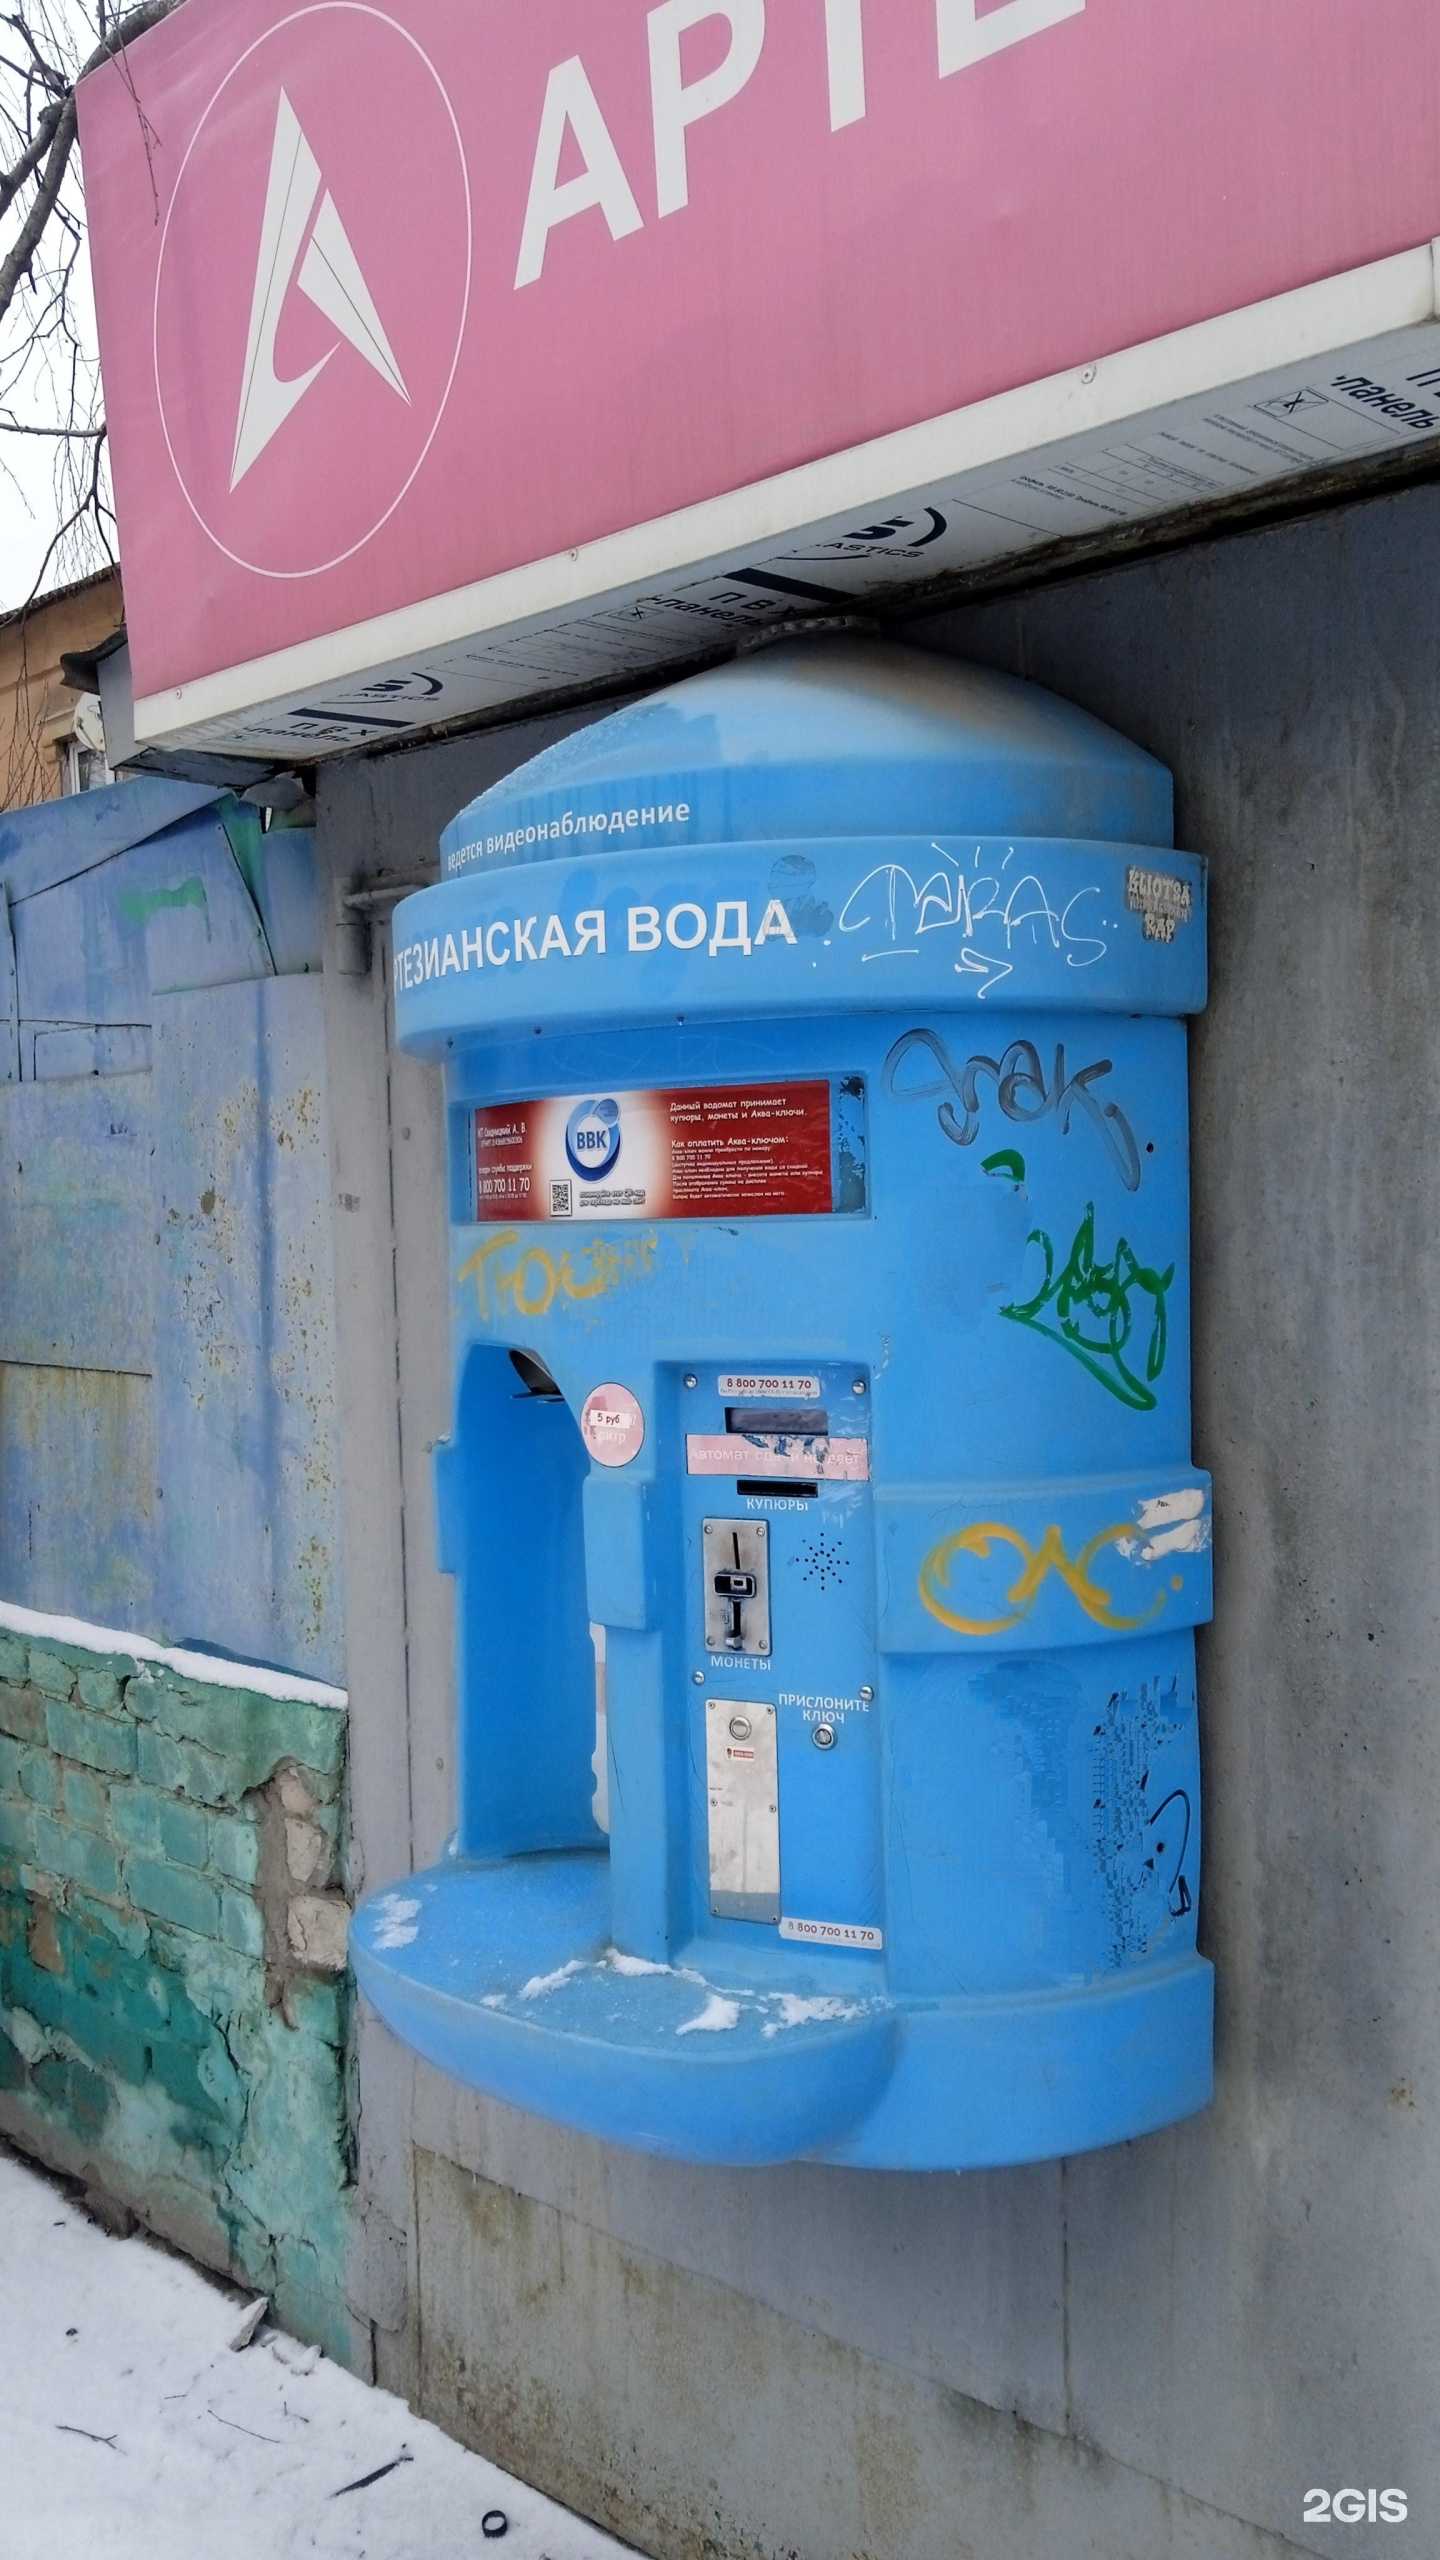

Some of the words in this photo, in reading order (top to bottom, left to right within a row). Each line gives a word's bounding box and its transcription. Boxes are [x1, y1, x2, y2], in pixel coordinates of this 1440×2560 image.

[447, 840, 483, 873] ведется
[486, 800, 691, 856] видеонаблюдение
[627, 898, 799, 958] ВОДА
[703, 1101, 737, 1110] водомат
[740, 1098, 787, 1110] принимает
[707, 1112, 739, 1121] монеты
[741, 1111, 748, 1119] и
[671, 1139, 686, 1148] Как
[687, 1139, 725, 1148] оплатить
[508, 1177, 517, 1192] 11
[519, 1176, 531, 1192] 70
[727, 1377, 733, 1388] 8
[736, 1378, 756, 1389] 800
[759, 1379, 779, 1389] 700
[782, 1380, 794, 1389] 11
[798, 1380, 812, 1390] 70
[597, 1412, 603, 1422] 5
[606, 1414, 621, 1426] руб
[746, 1498, 809, 1511] КУПЮРЫ
[710, 1656, 771, 1671] МОНЕТЫ
[778, 1693, 870, 1713] ПРИСЛОНИТЕ
[802, 1710, 846, 1724] КЛЮЧ
[797, 1922, 818, 1935] 800
[820, 1926, 841, 1937] 700
[843, 1928, 857, 1939] 11
[860, 1931, 874, 1942] 70
